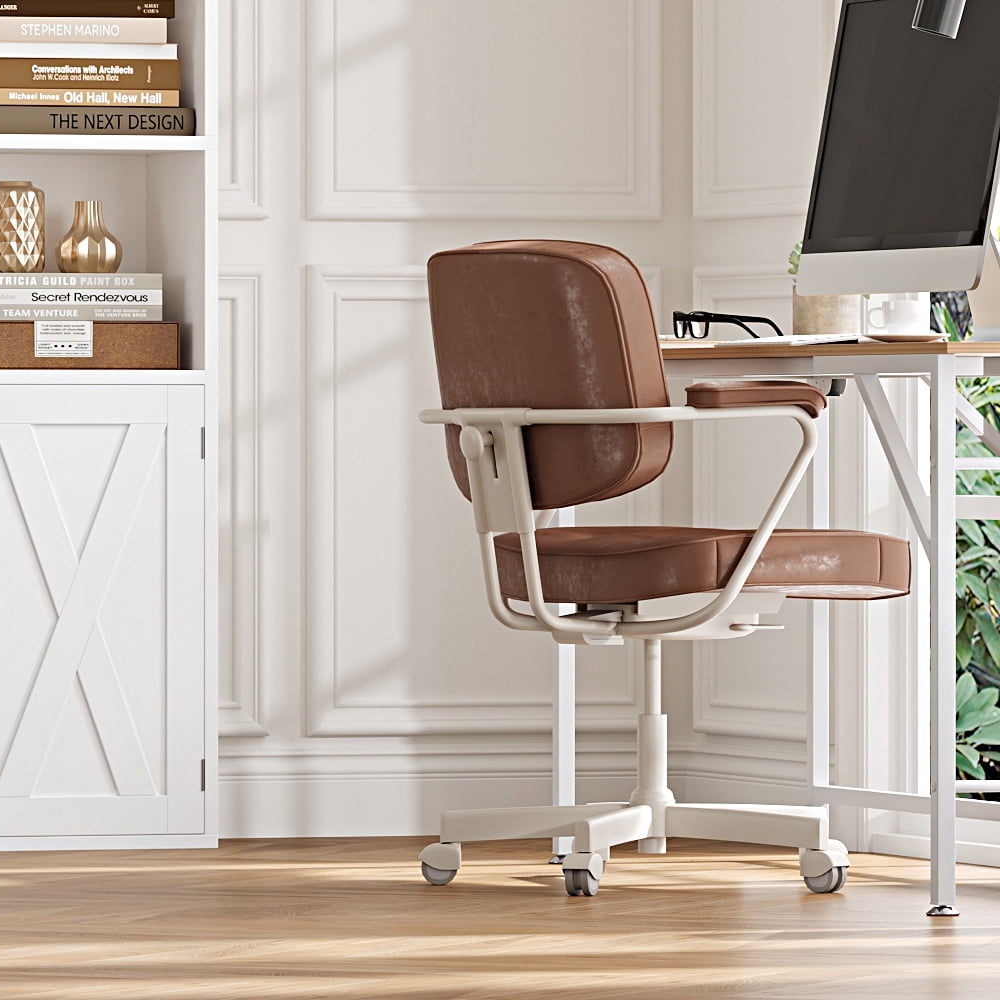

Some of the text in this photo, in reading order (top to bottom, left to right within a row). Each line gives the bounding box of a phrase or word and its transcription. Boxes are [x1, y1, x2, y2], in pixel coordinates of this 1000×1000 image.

[20, 24, 120, 37] STEPHEN MARINO
[31, 64, 134, 75] Conversations with Architects
[32, 73, 47, 81] John
[82, 74, 105, 82] Heinrich
[105, 74, 119, 82] Klotz
[9, 92, 60, 101] Michael Innes
[63, 91, 162, 105] Old Hall, New Hall
[50, 113, 184, 131] THE NEXT DESIGN
[42, 277, 77, 286] GUILD
[80, 277, 110, 286] PAINT
[114, 277, 135, 286] BOX
[31, 292, 149, 303] Secret Rendezvous
[3, 309, 32, 317] TEAM
[33, 309, 79, 317] VENTURE
